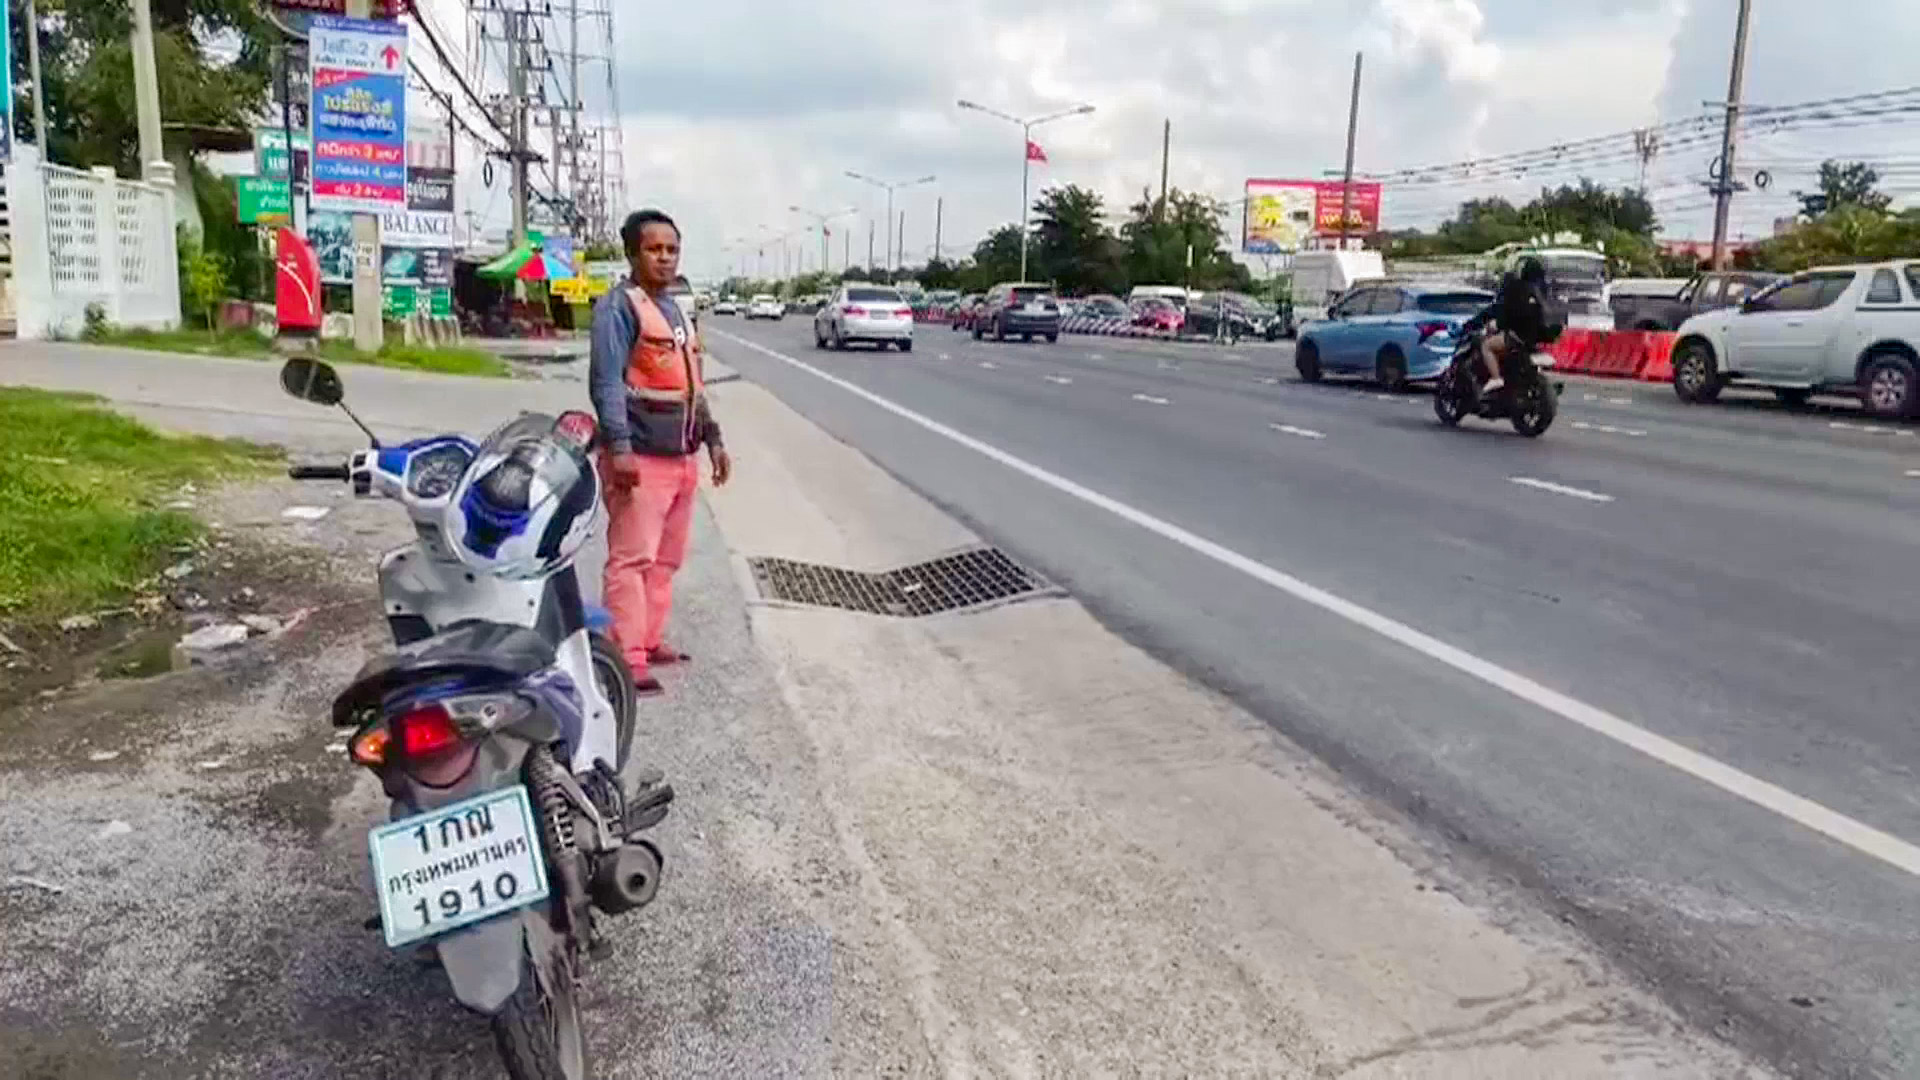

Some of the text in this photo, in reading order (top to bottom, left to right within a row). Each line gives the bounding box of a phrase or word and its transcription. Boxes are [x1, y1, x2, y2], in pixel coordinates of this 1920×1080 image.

[415, 805, 494, 854] 1กณ
[389, 837, 527, 894] กรุงเทพมหานคร
[414, 870, 517, 925] 1910
